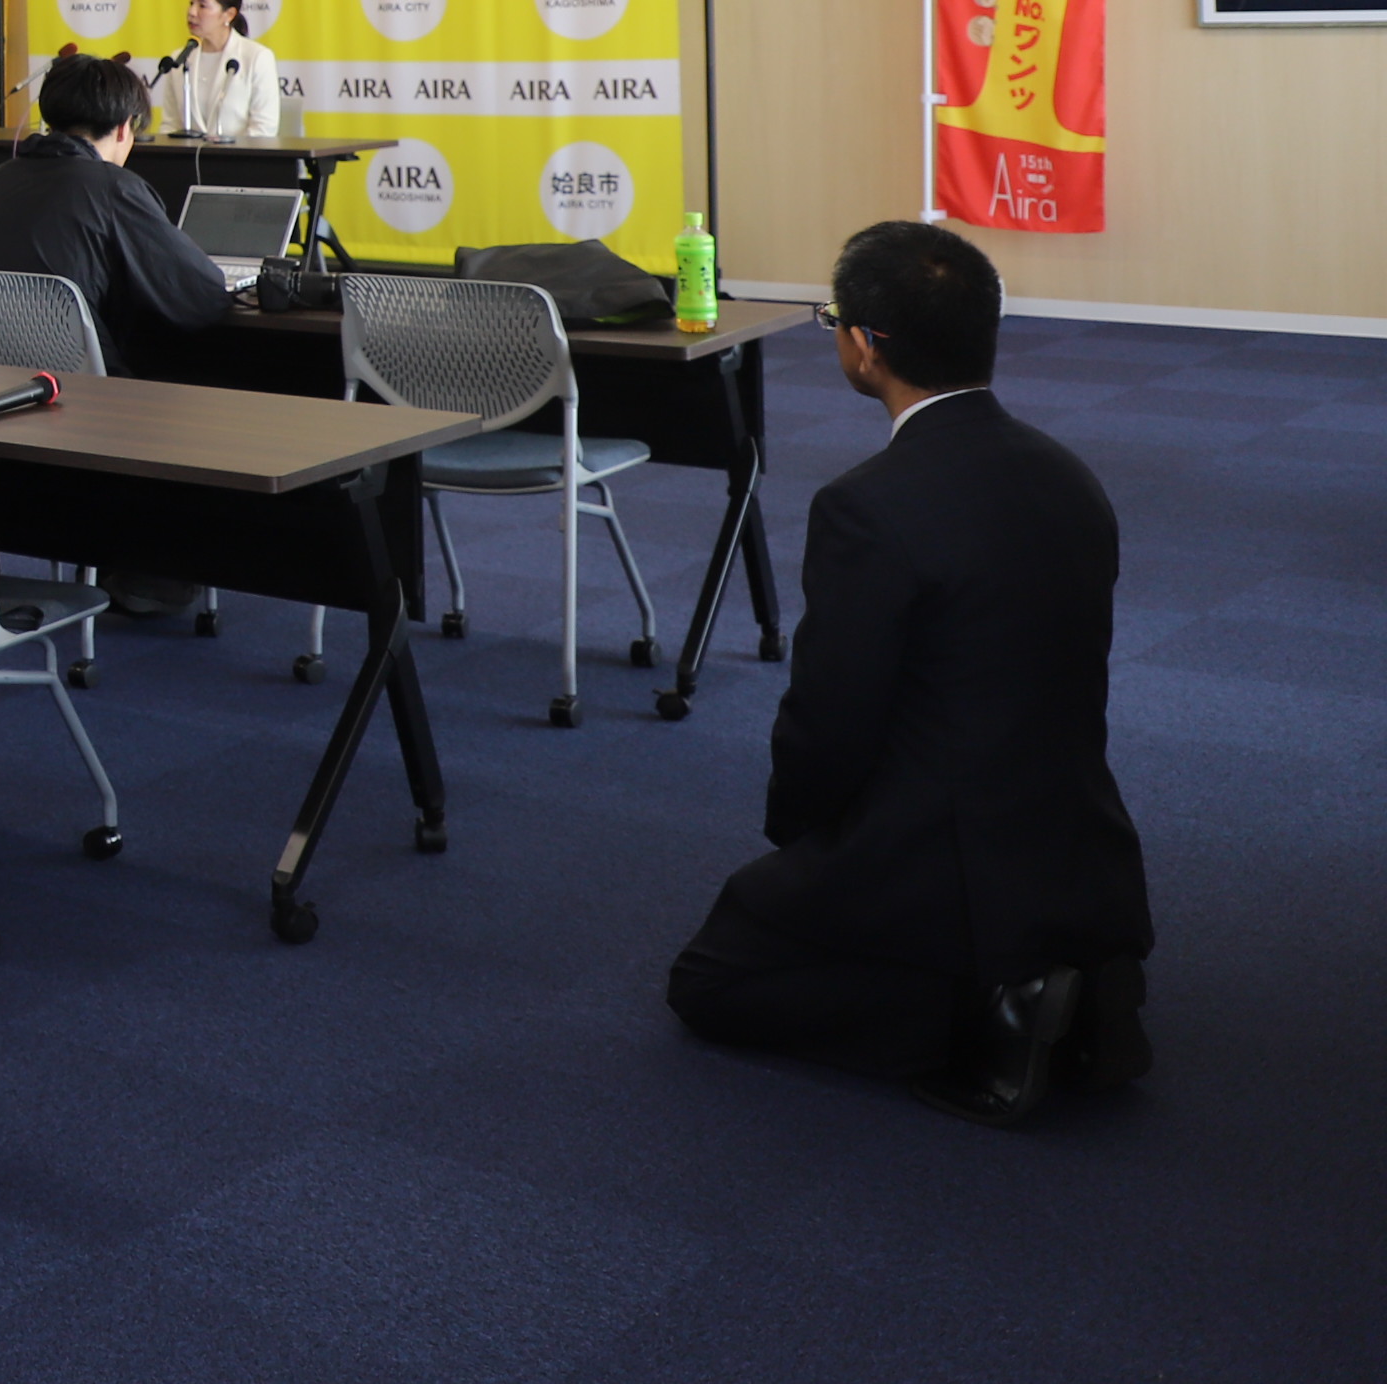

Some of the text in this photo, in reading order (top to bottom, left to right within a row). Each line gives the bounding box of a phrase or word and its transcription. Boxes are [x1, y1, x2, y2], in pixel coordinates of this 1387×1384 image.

[70, 2, 117, 12] AIRA CITY
[377, 2, 430, 13] AIRA CITY
[279, 76, 658, 101] RA AIRA AIRA AIRA AIRA
[1018, 154, 1054, 171] 15th
[378, 165, 442, 190] AIRA
[551, 172, 619, 195] 姶良市
[987, 151, 1058, 222] Aira
[378, 191, 442, 203] KAGOSHIMA
[558, 199, 614, 210] AIRA CITY
